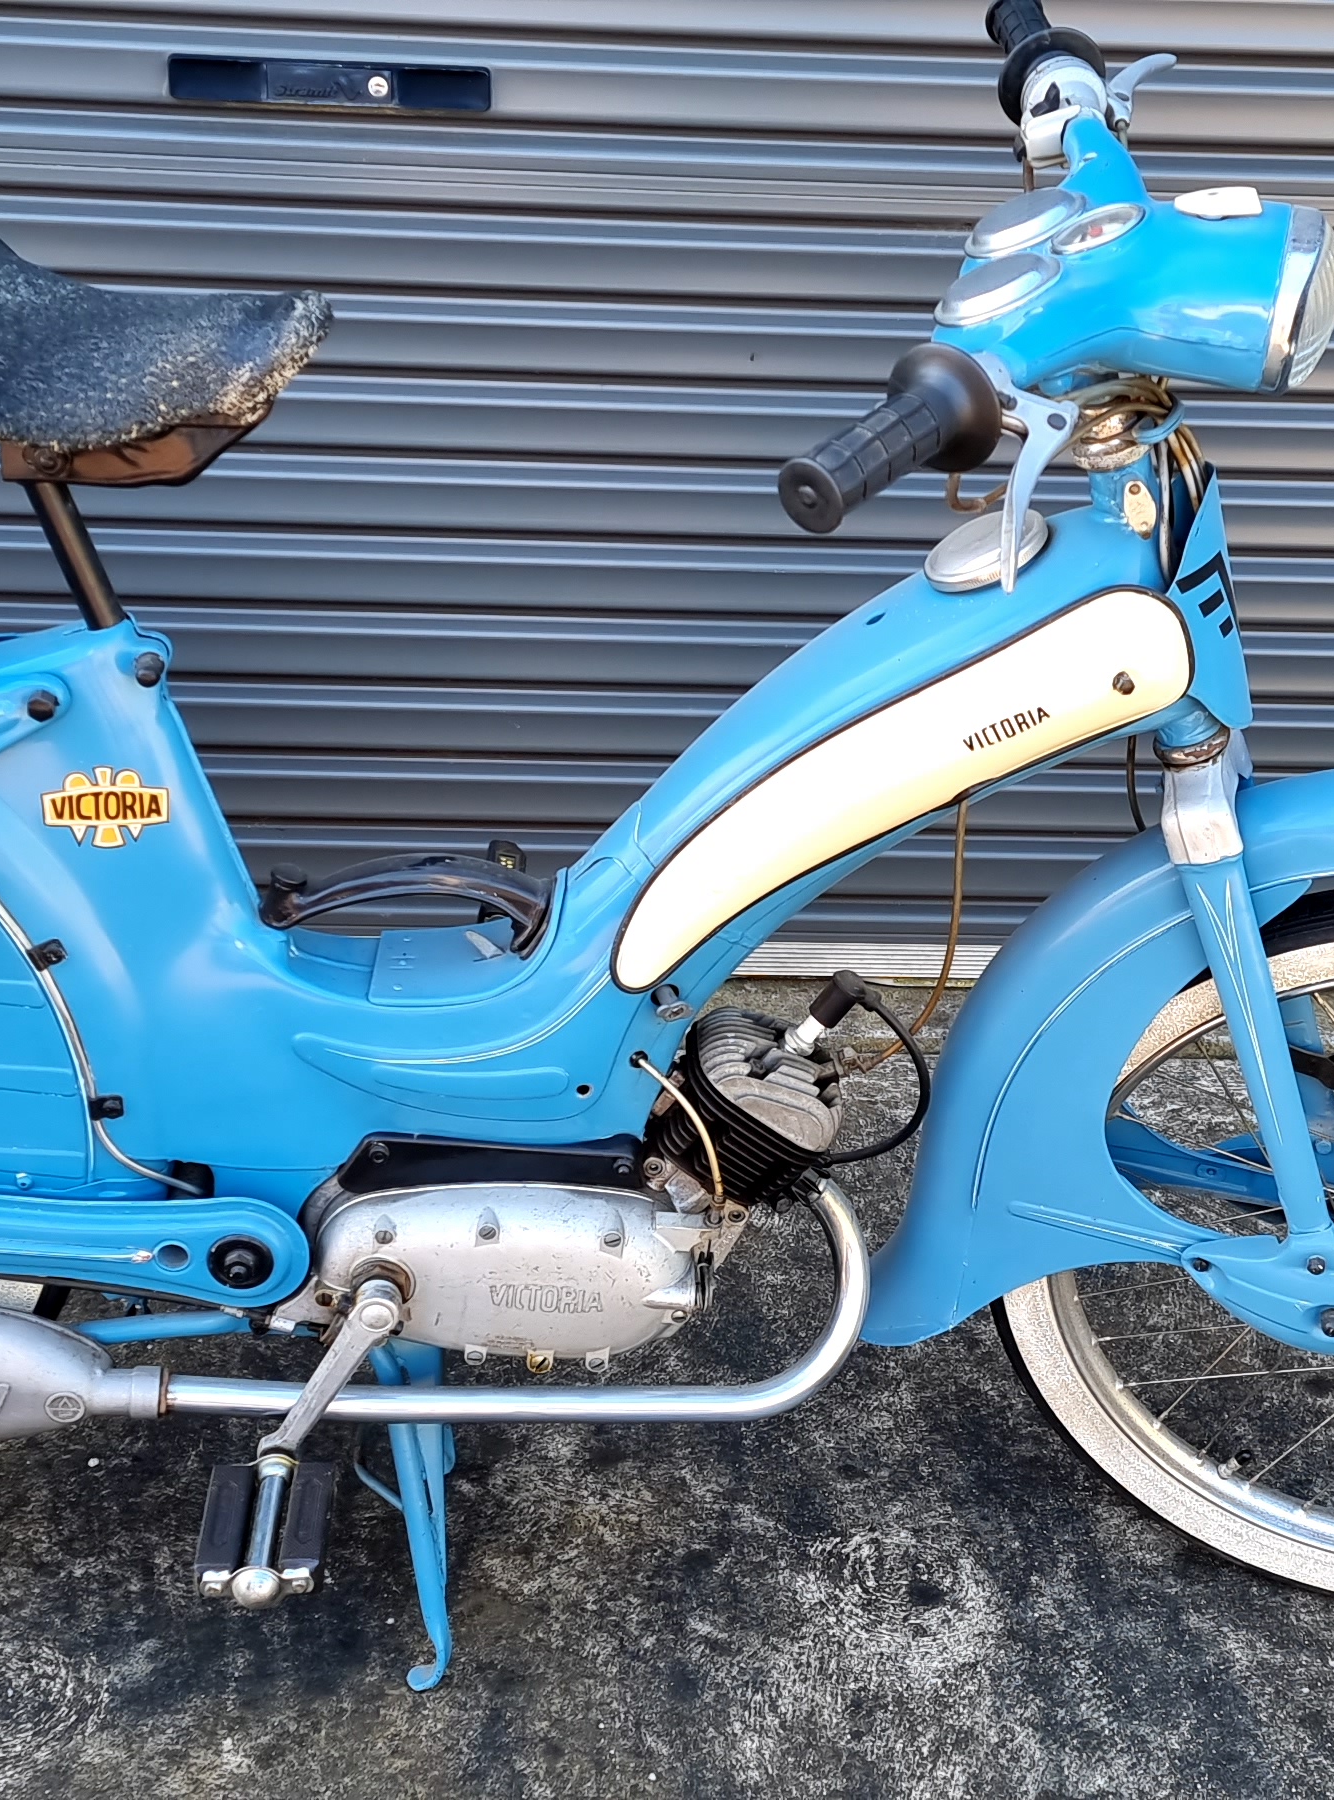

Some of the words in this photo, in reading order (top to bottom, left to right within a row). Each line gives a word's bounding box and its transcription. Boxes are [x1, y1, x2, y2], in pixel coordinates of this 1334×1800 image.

[963, 706, 1050, 751] VICTORIA
[50, 791, 163, 821] VICTORIA
[489, 1283, 604, 1314] VICTORIA
